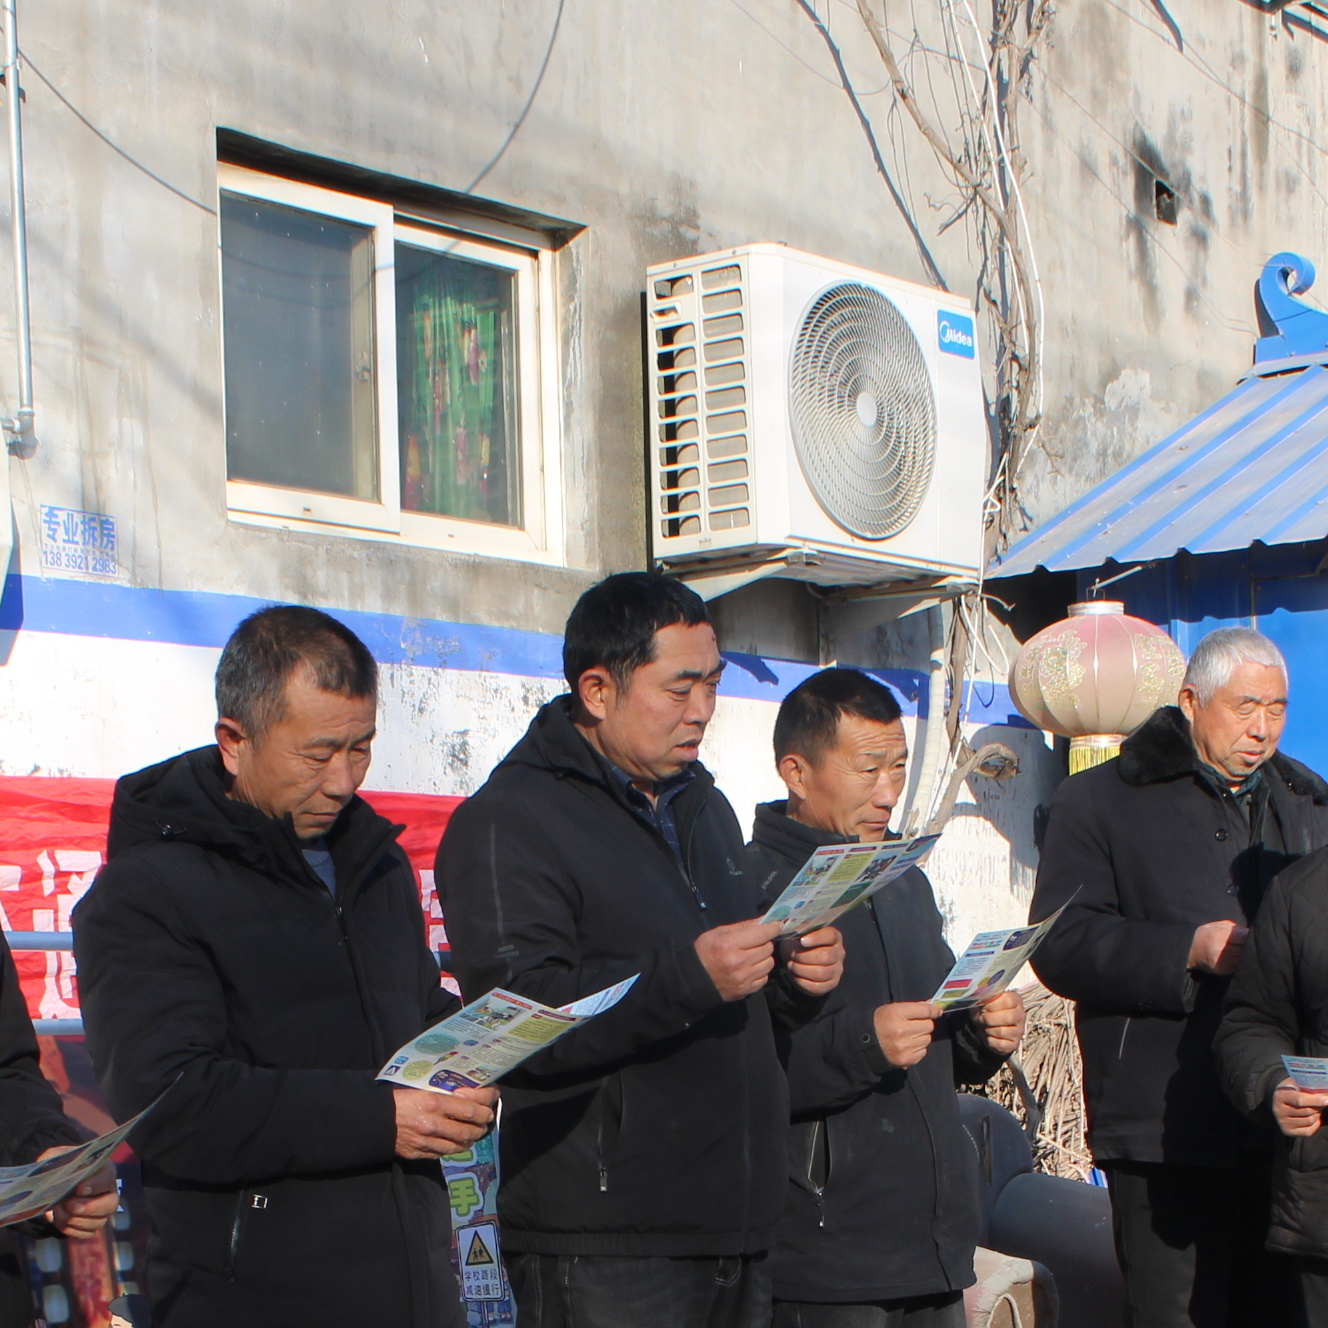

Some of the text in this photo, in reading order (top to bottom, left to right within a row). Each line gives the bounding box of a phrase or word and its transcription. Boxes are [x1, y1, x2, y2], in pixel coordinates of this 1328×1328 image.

[939, 320, 973, 348] Midea
[43, 507, 116, 552] 专业拆房
[43, 550, 62, 567] 138
[464, 1268, 498, 1282] 学校路段
[466, 1283, 499, 1296] 减速慢行
